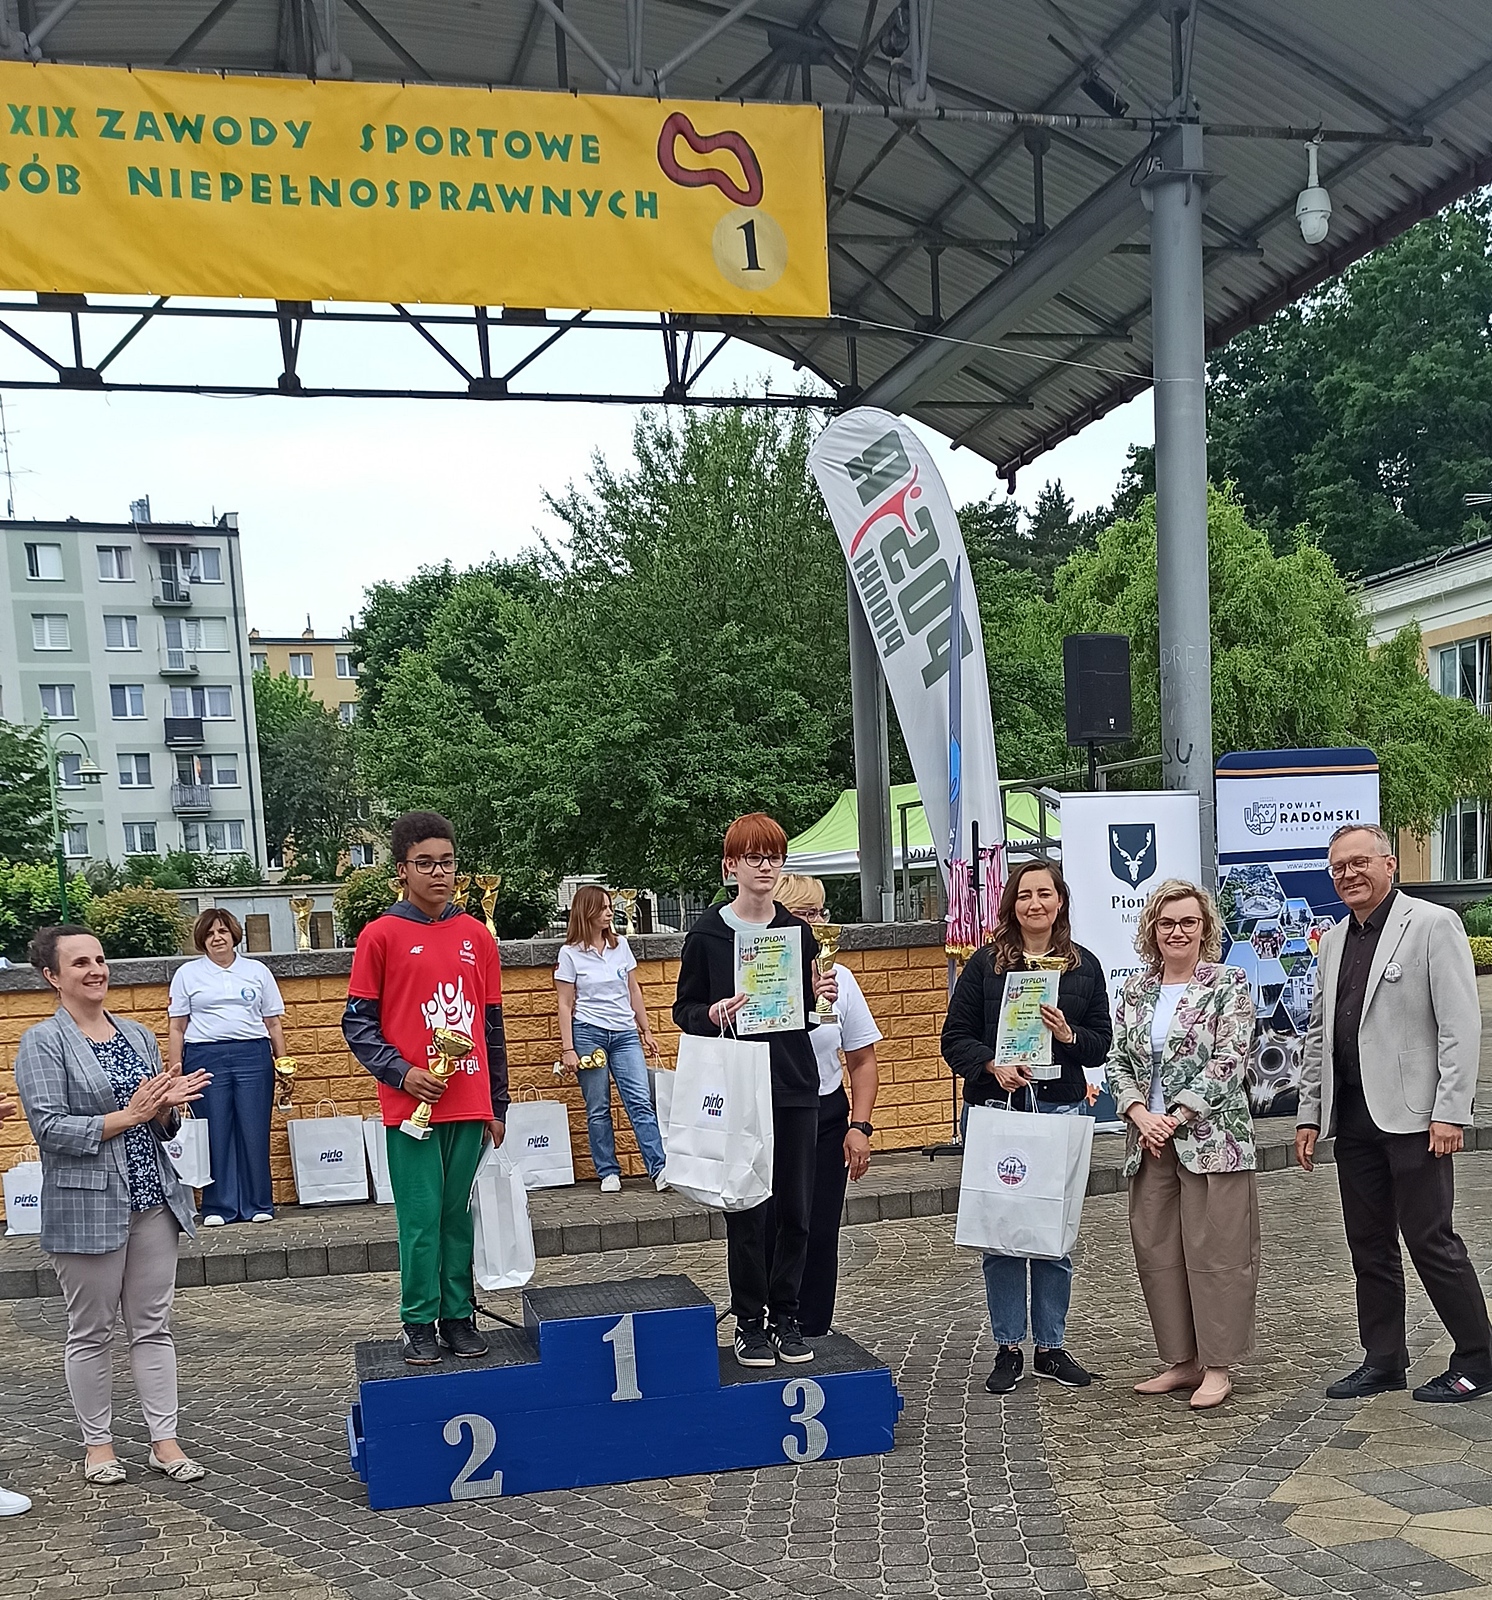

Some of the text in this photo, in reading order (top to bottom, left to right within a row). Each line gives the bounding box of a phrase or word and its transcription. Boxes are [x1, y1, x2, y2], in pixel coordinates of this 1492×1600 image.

[7, 103, 600, 164] XIX ZAWODY SPORTOWE
[127, 165, 658, 219] NIEPEŁNOSPRAWNYCH
[736, 218, 766, 272] 1
[1280, 801, 1321, 809] POWIAT
[1280, 810, 1360, 823] RADOMSKI
[1111, 892, 1149, 909] Pion
[754, 935, 786, 944] DYPLOM
[702, 1092, 724, 1111] pirlo
[528, 1134, 549, 1147] pirlo
[320, 1149, 343, 1162] pirlo
[13, 1193, 38, 1206] pirlo
[603, 1313, 643, 1401] 1
[782, 1378, 829, 1463] 3
[443, 1413, 503, 1500] 2
